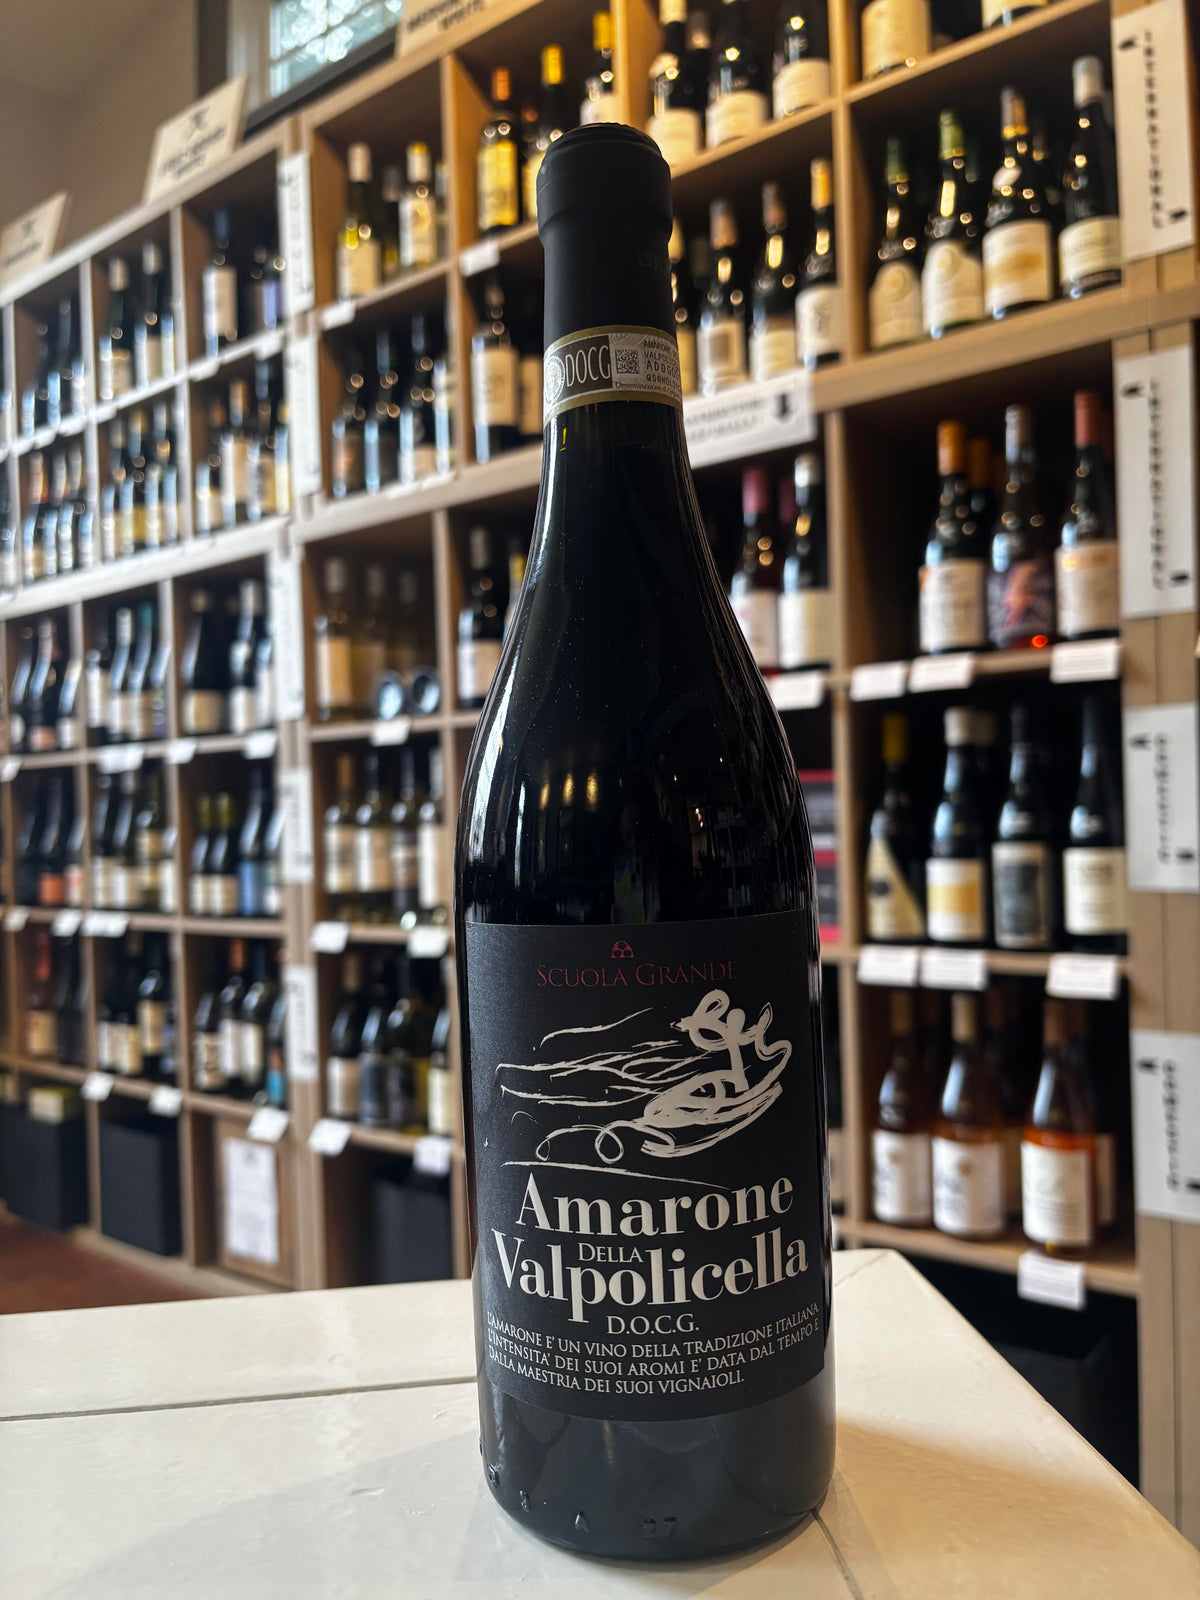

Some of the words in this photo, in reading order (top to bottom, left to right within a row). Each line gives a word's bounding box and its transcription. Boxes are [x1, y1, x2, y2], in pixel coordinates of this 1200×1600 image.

[565, 345, 611, 388] DOCG
[536, 964, 628, 988] SCUOLA
[635, 960, 736, 987] GRANDE
[515, 1171, 794, 1237] Amarone
[490, 1226, 809, 1323] Valpolicella
[577, 1242, 645, 1264] DELLA
[487, 1311, 542, 1347] L'AMARONE
[546, 1335, 555, 1349] E'
[558, 1338, 581, 1354] UN
[584, 1342, 627, 1358] VINO
[631, 1343, 681, 1359] DELLA
[683, 1324, 773, 1356] TRADIZIONE
[775, 1302, 820, 1335] ITALIANA
[487, 1328, 550, 1367] L'INTENSITA'
[554, 1355, 580, 1372] DEI
[584, 1360, 623, 1376] SUOI
[627, 1361, 685, 1377] AROMI
[690, 1358, 702, 1373] E'
[707, 1351, 747, 1371] DATA
[750, 1341, 776, 1362] DAL
[777, 1322, 813, 1351] TEMPO
[813, 1317, 820, 1332] E
[606, 1313, 700, 1336] D.O.C.G.
[488, 1345, 516, 1372] DALLA
[517, 1362, 581, 1391] MAESTRIA
[584, 1377, 611, 1393] DEI
[615, 1379, 654, 1395] SUOI
[657, 1369, 745, 1394] VIGNAIOLI.
